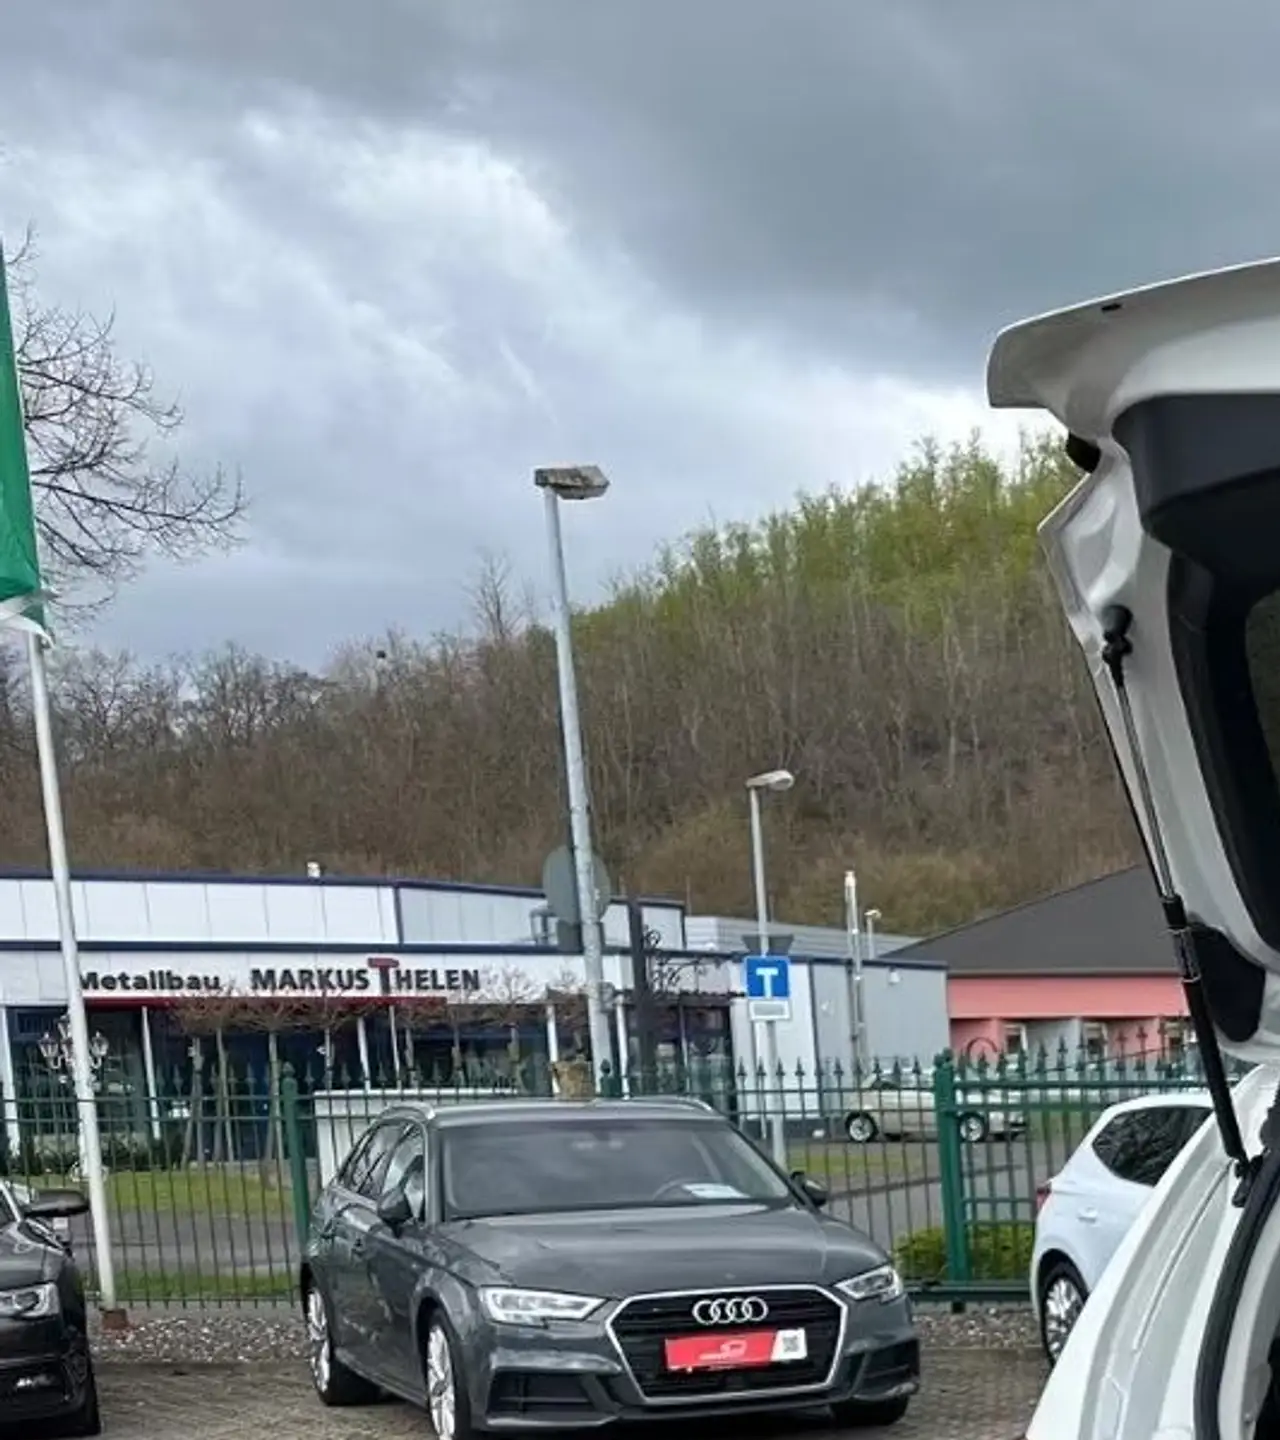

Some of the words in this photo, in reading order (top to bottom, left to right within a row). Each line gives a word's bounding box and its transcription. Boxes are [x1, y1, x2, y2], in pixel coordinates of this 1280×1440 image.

[80, 970, 221, 991] Metallbau
[251, 968, 370, 991] MARKUS
[367, 957, 480, 995] THELEN
